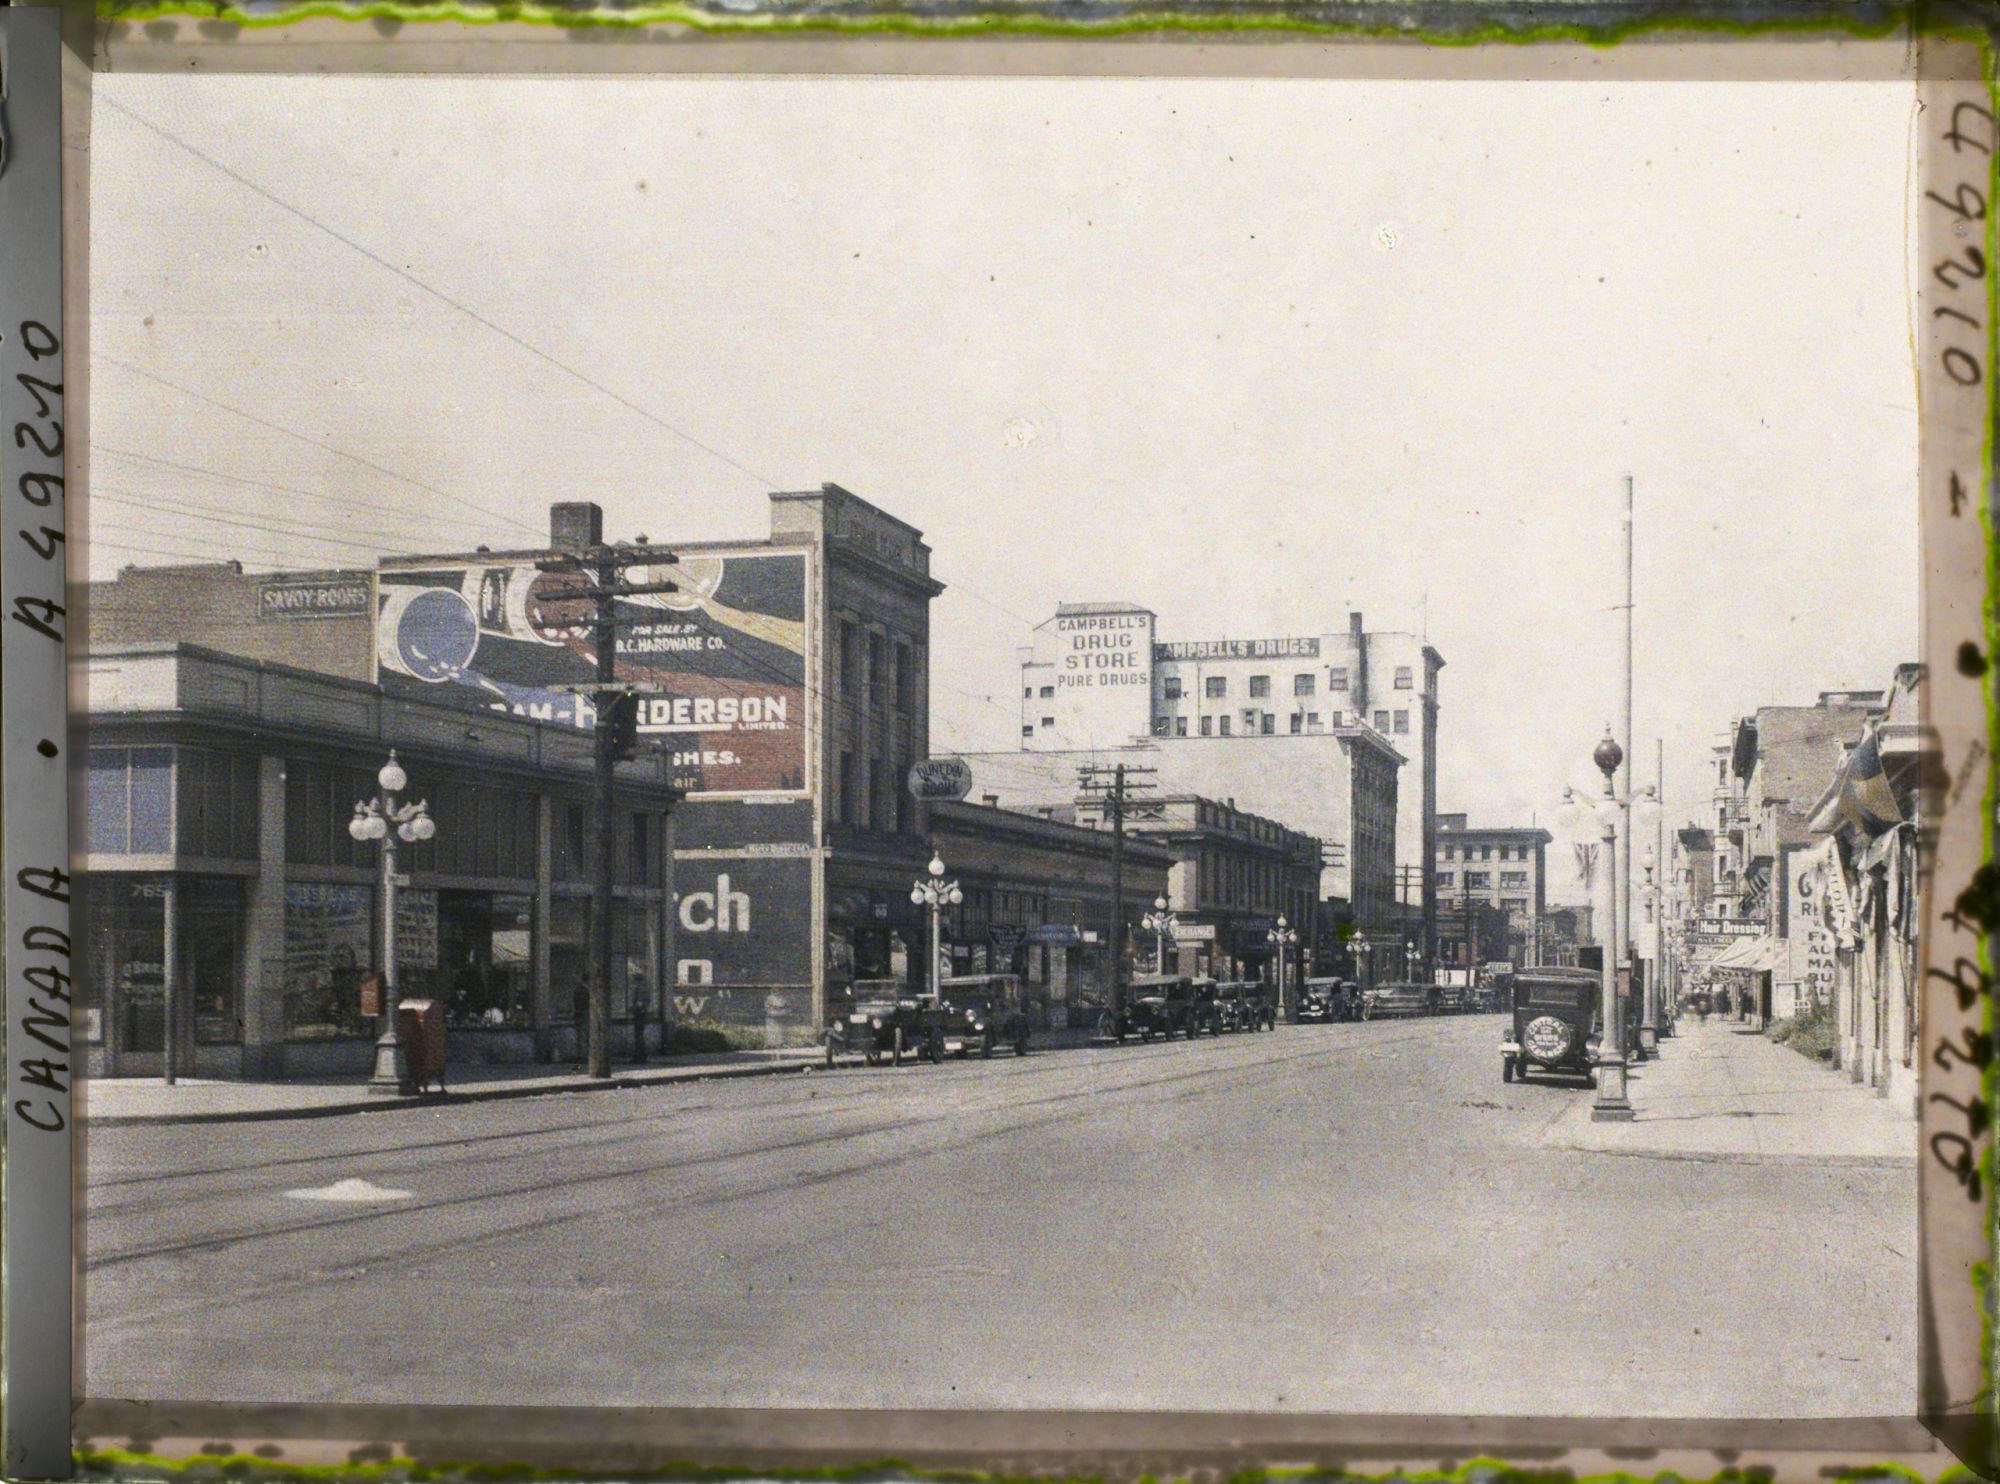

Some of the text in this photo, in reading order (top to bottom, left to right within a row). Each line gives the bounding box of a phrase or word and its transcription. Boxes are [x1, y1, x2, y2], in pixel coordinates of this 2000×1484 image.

[1926, 101, 1995, 386] 49210
[264, 586, 367, 609] SAVOY ROOMS
[631, 625, 652, 635] FOR
[654, 624, 681, 634] SALE
[1058, 617, 1147, 631] CAMPBELL'S
[707, 636, 727, 650] CO.
[1073, 633, 1132, 650] DRUG
[1158, 637, 1316, 658] AMPBELL'S DRUGS.
[1066, 651, 1138, 670] STORE
[1058, 673, 1147, 687] PURE DRUGS
[11, 319, 71, 1132] CANADA A 49210
[673, 873, 750, 932] ch
[1699, 920, 1766, 937] Hair Dressing
